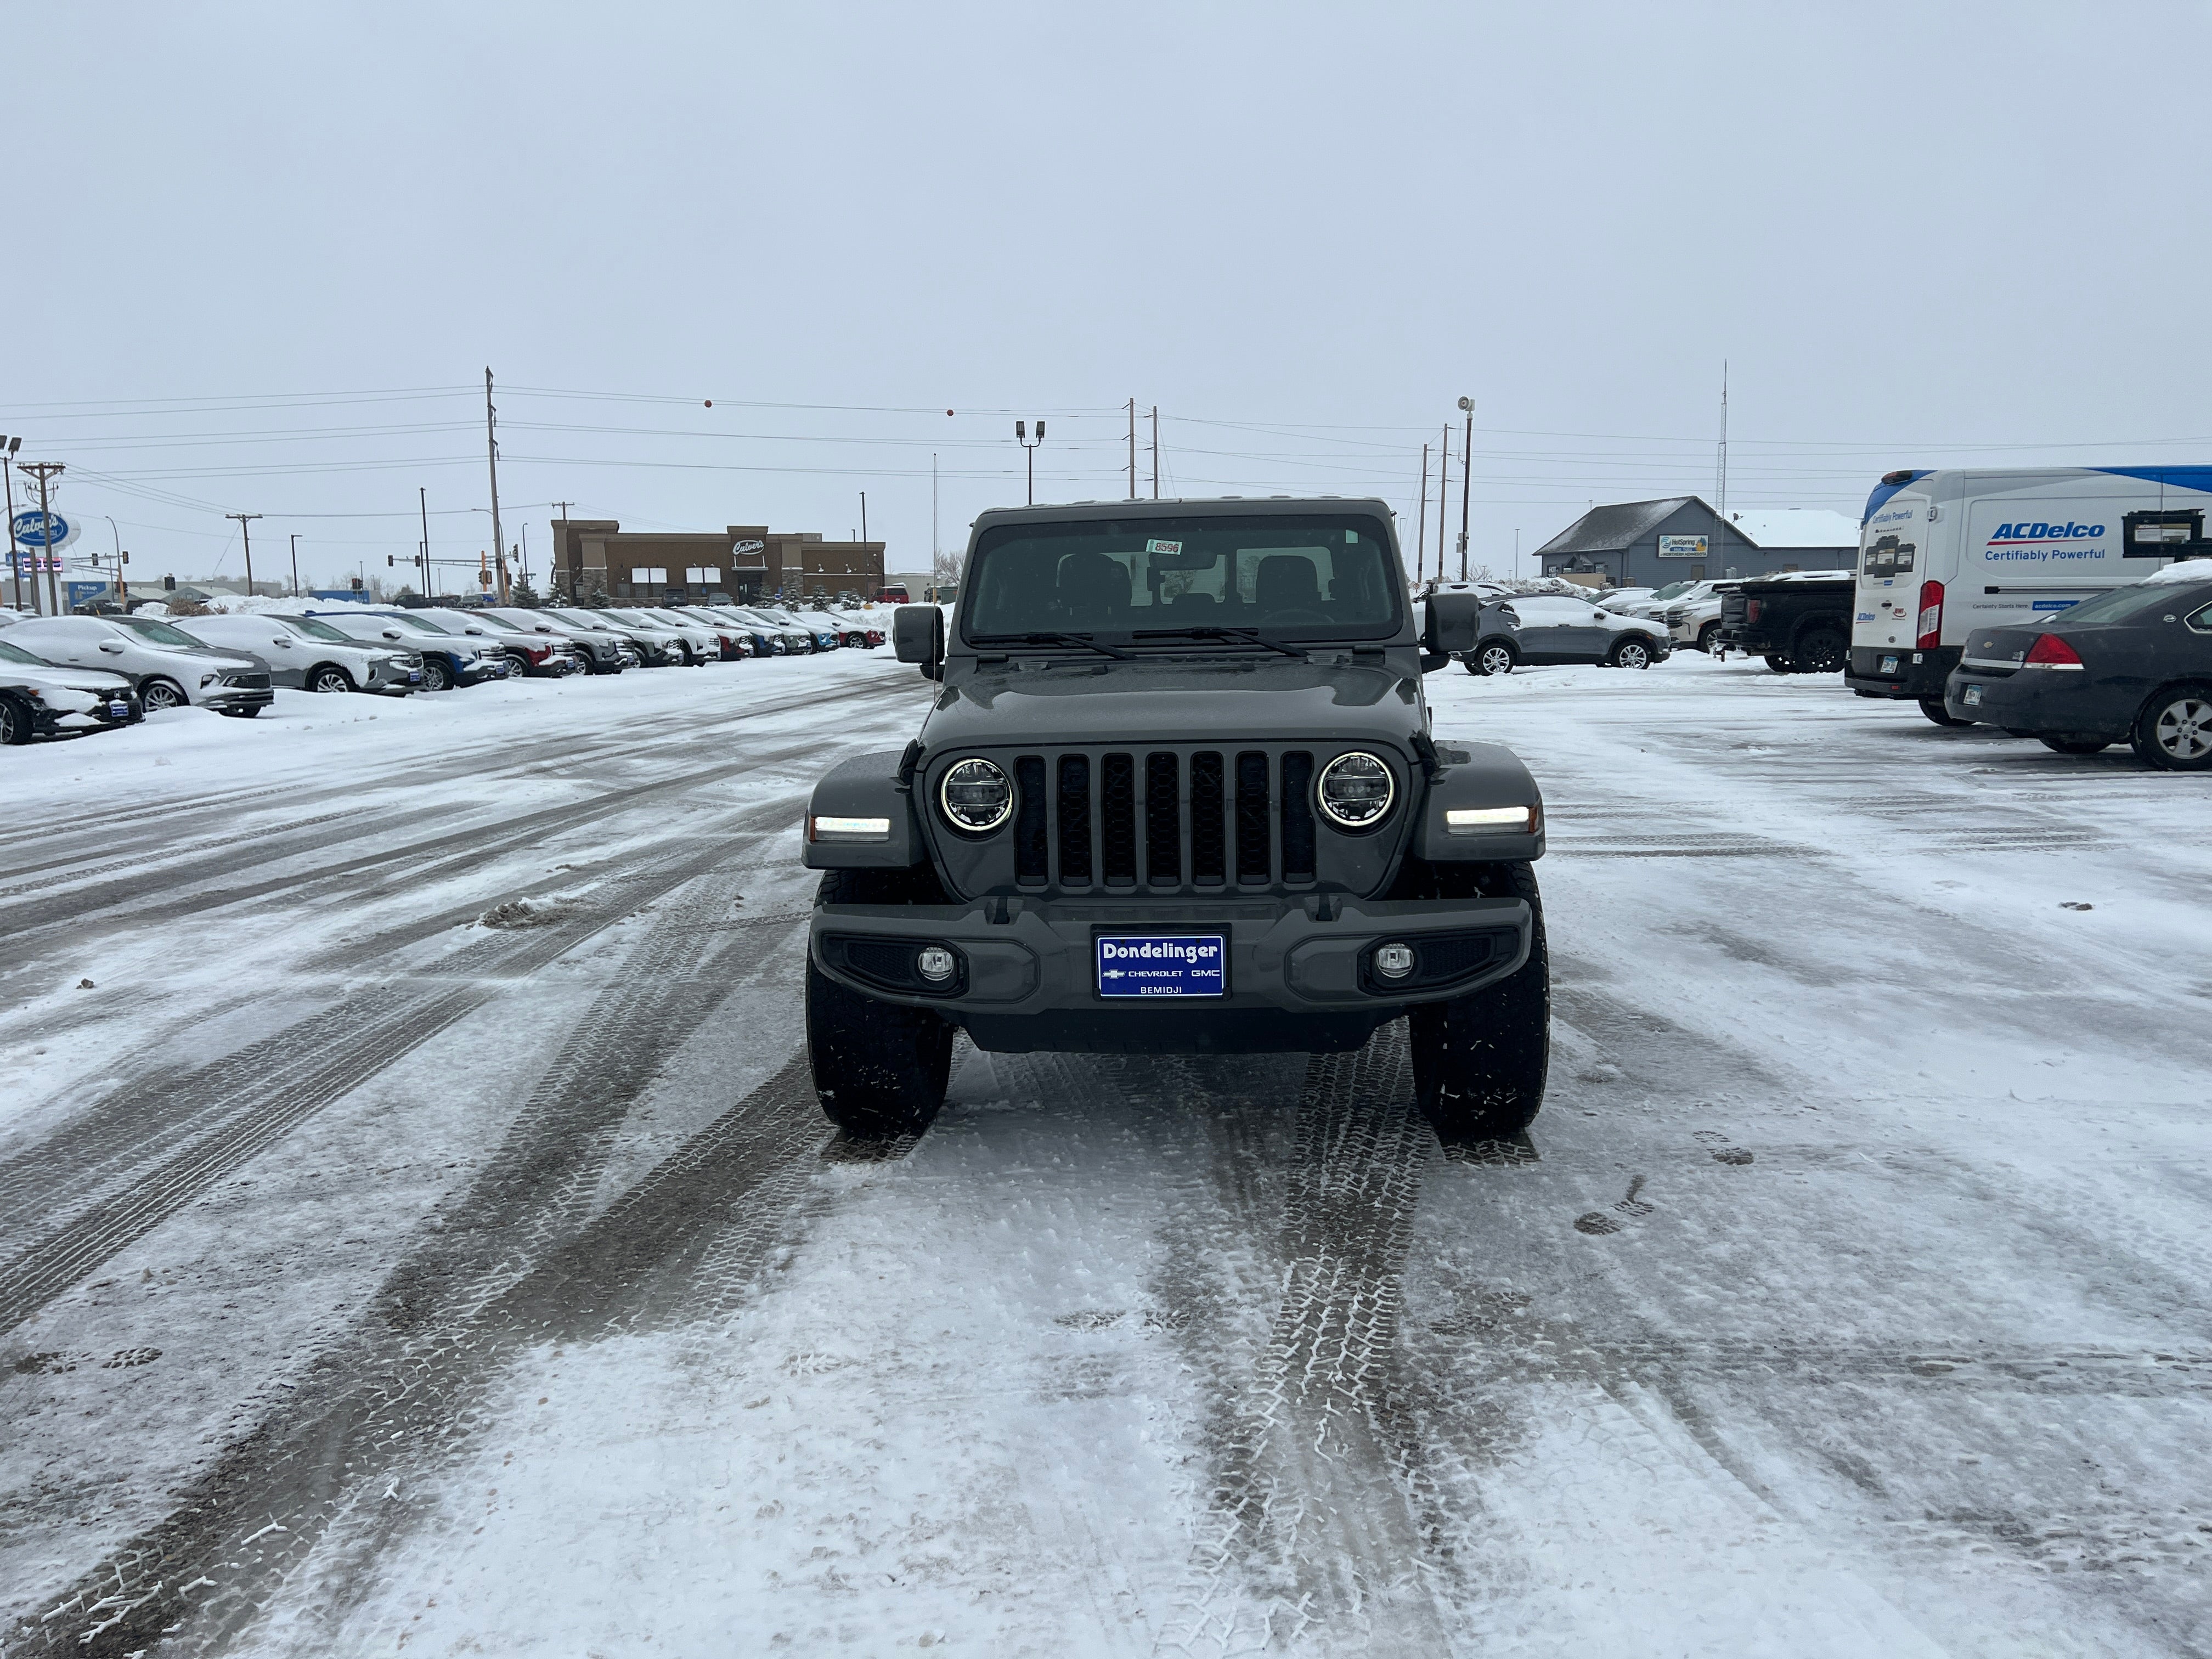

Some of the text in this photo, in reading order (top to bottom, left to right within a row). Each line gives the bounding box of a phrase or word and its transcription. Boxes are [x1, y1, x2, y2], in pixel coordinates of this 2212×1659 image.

[14, 515, 59, 538] Culv's
[1991, 521, 2106, 539] ACDelco
[733, 540, 764, 555] Culver's
[1155, 543, 1179, 552] 8596
[1985, 549, 2105, 562] Certifiably Powerful
[1103, 943, 1217, 963] Dondelinger
